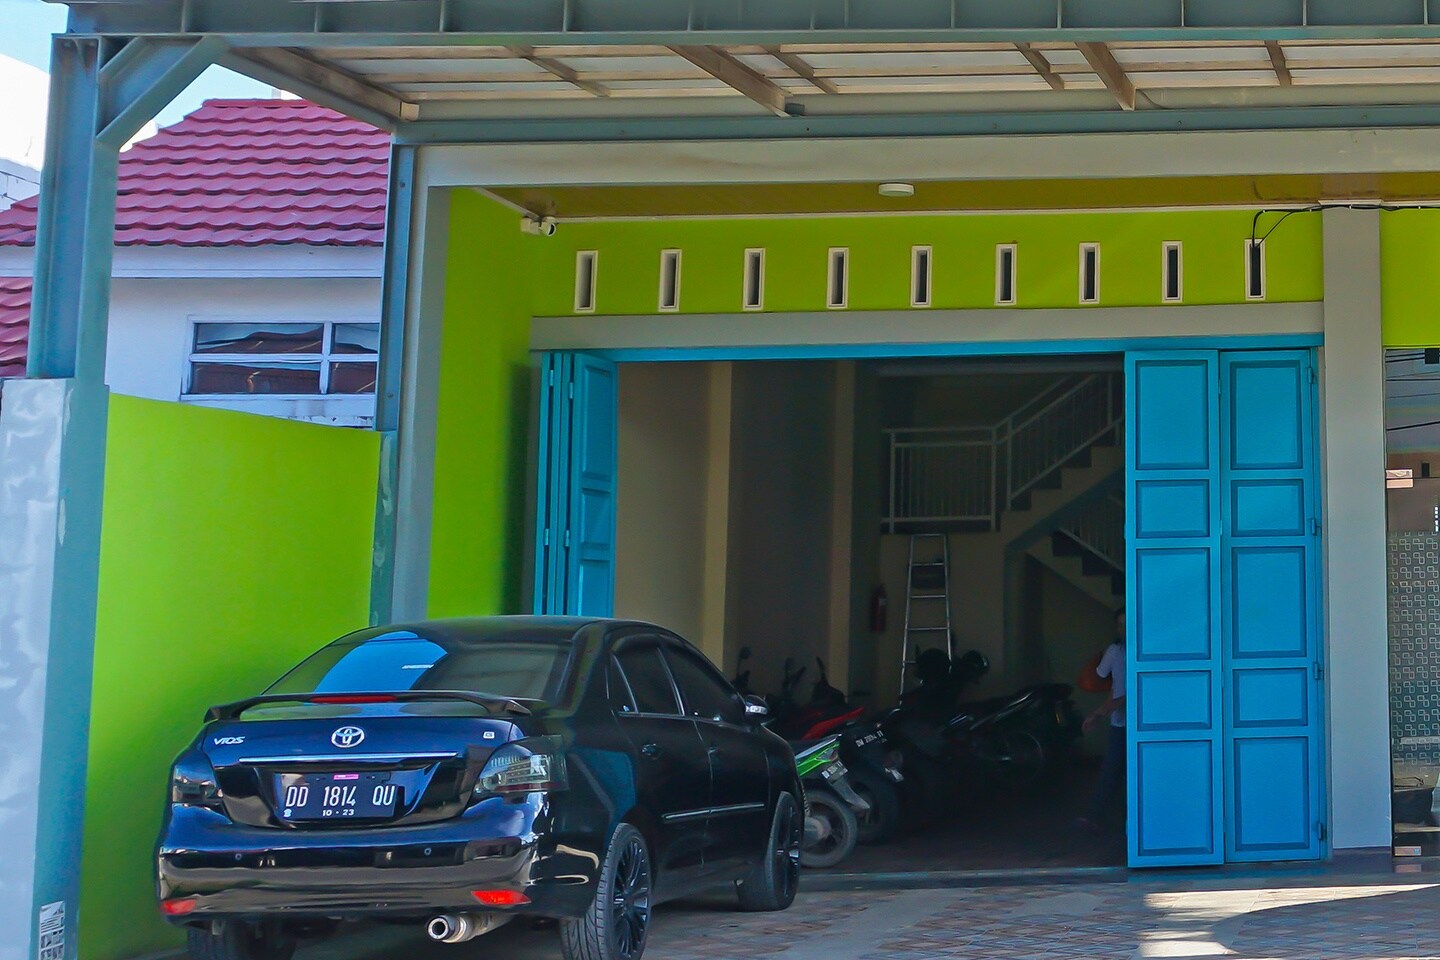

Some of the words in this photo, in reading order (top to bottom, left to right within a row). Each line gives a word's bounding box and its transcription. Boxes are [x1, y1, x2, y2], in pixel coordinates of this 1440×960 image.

[285, 786, 309, 807] DD
[323, 785, 357, 807] 1814
[372, 785, 395, 806] QU
